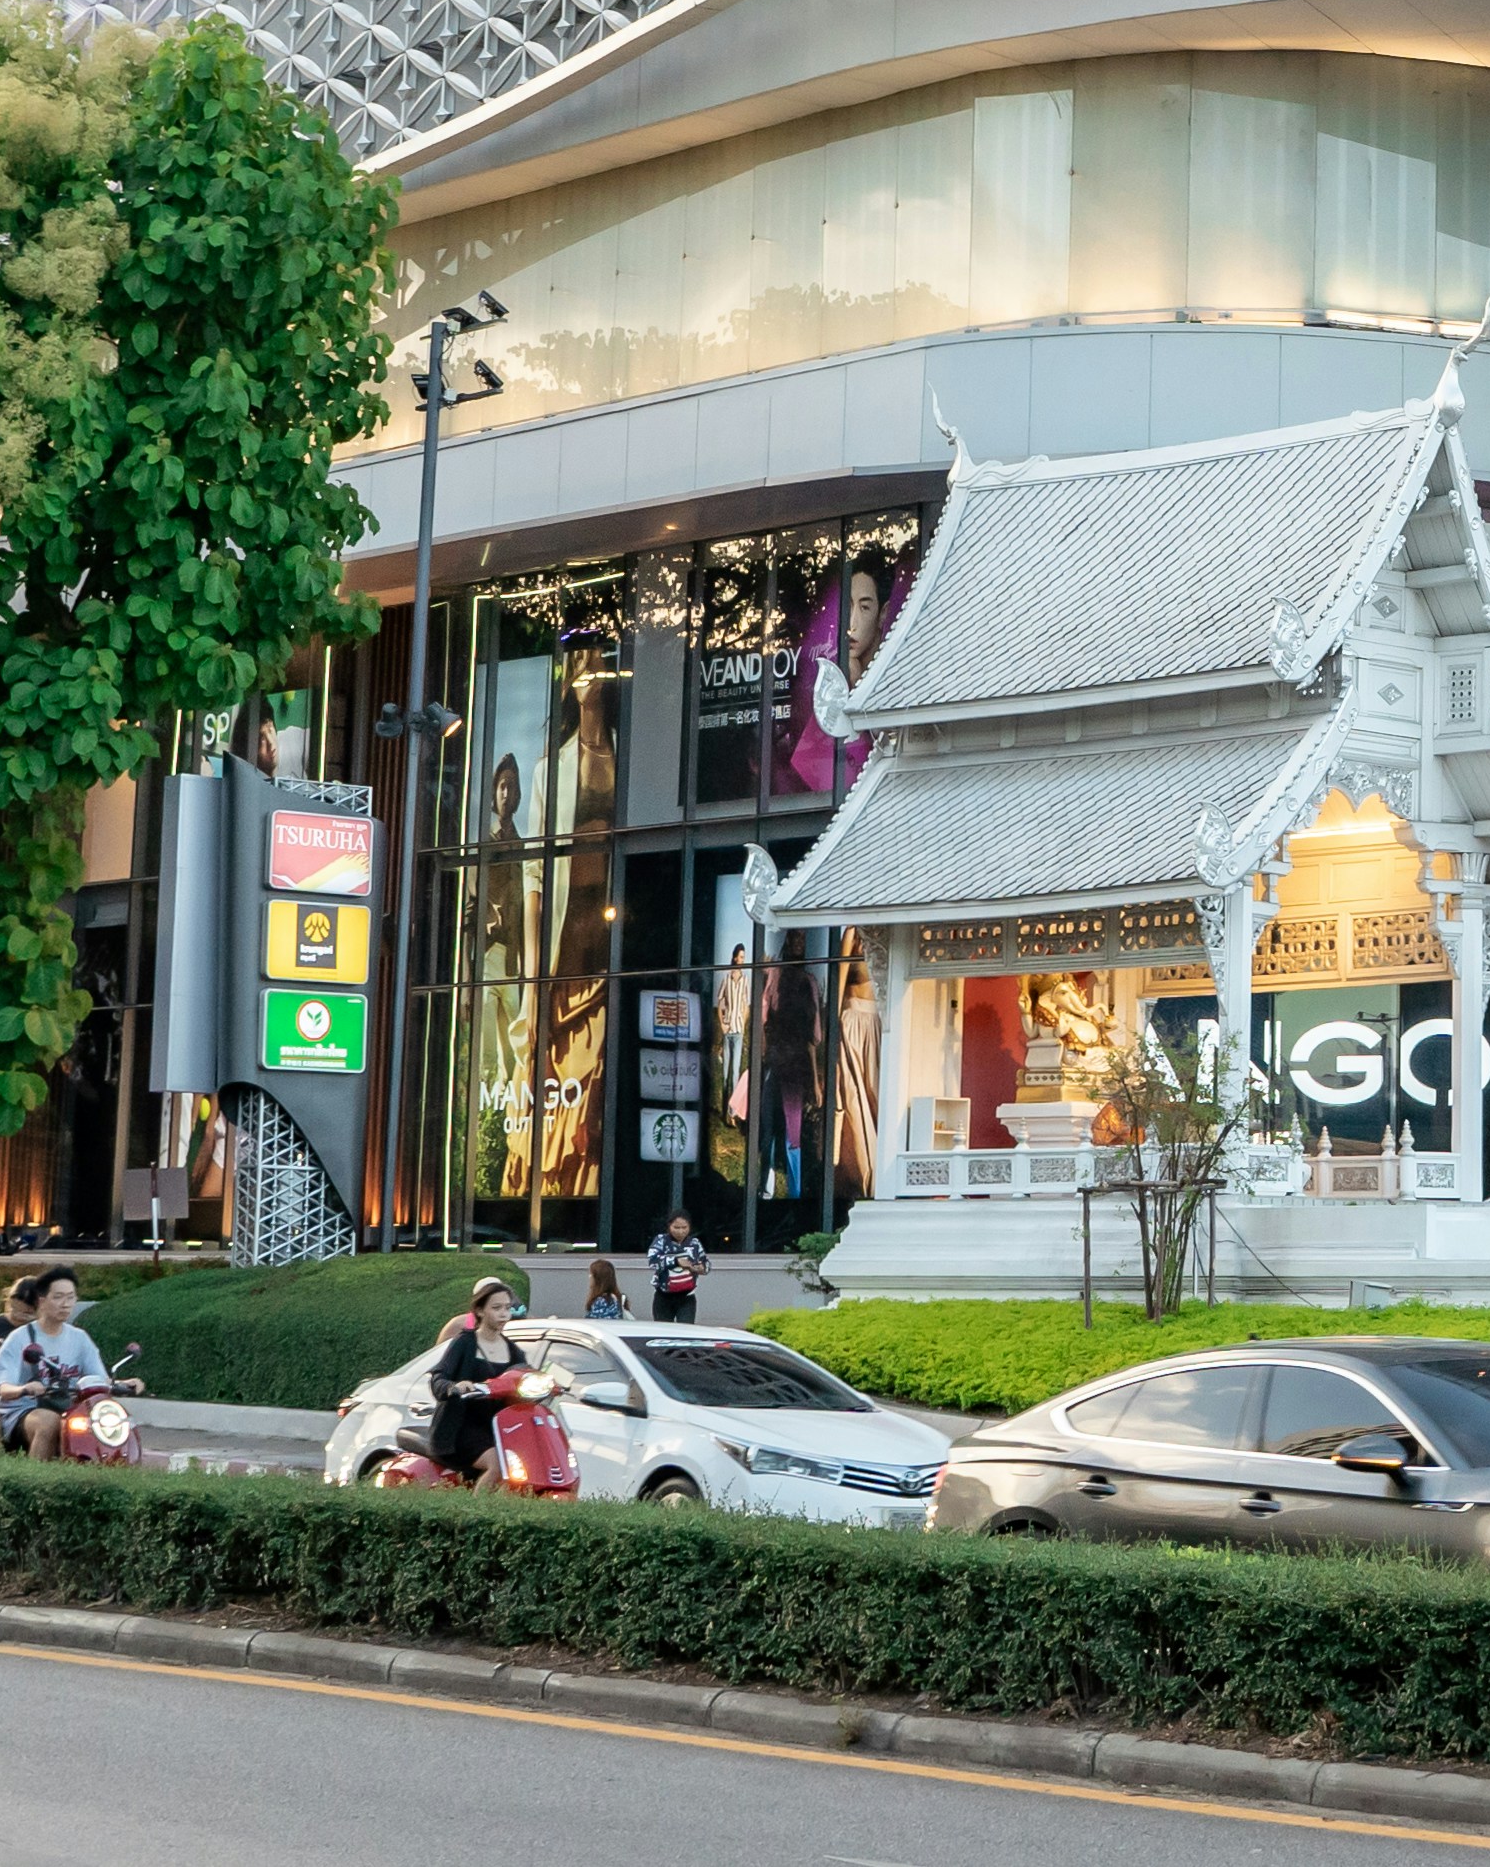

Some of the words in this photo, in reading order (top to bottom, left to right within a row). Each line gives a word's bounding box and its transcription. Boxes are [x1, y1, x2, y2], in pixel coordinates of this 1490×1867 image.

[700, 645, 802, 688] VEANDOY
[717, 684, 747, 699] BEAUTY
[275, 824, 368, 852] TSURUHA
[479, 1077, 582, 1111] MANGO
